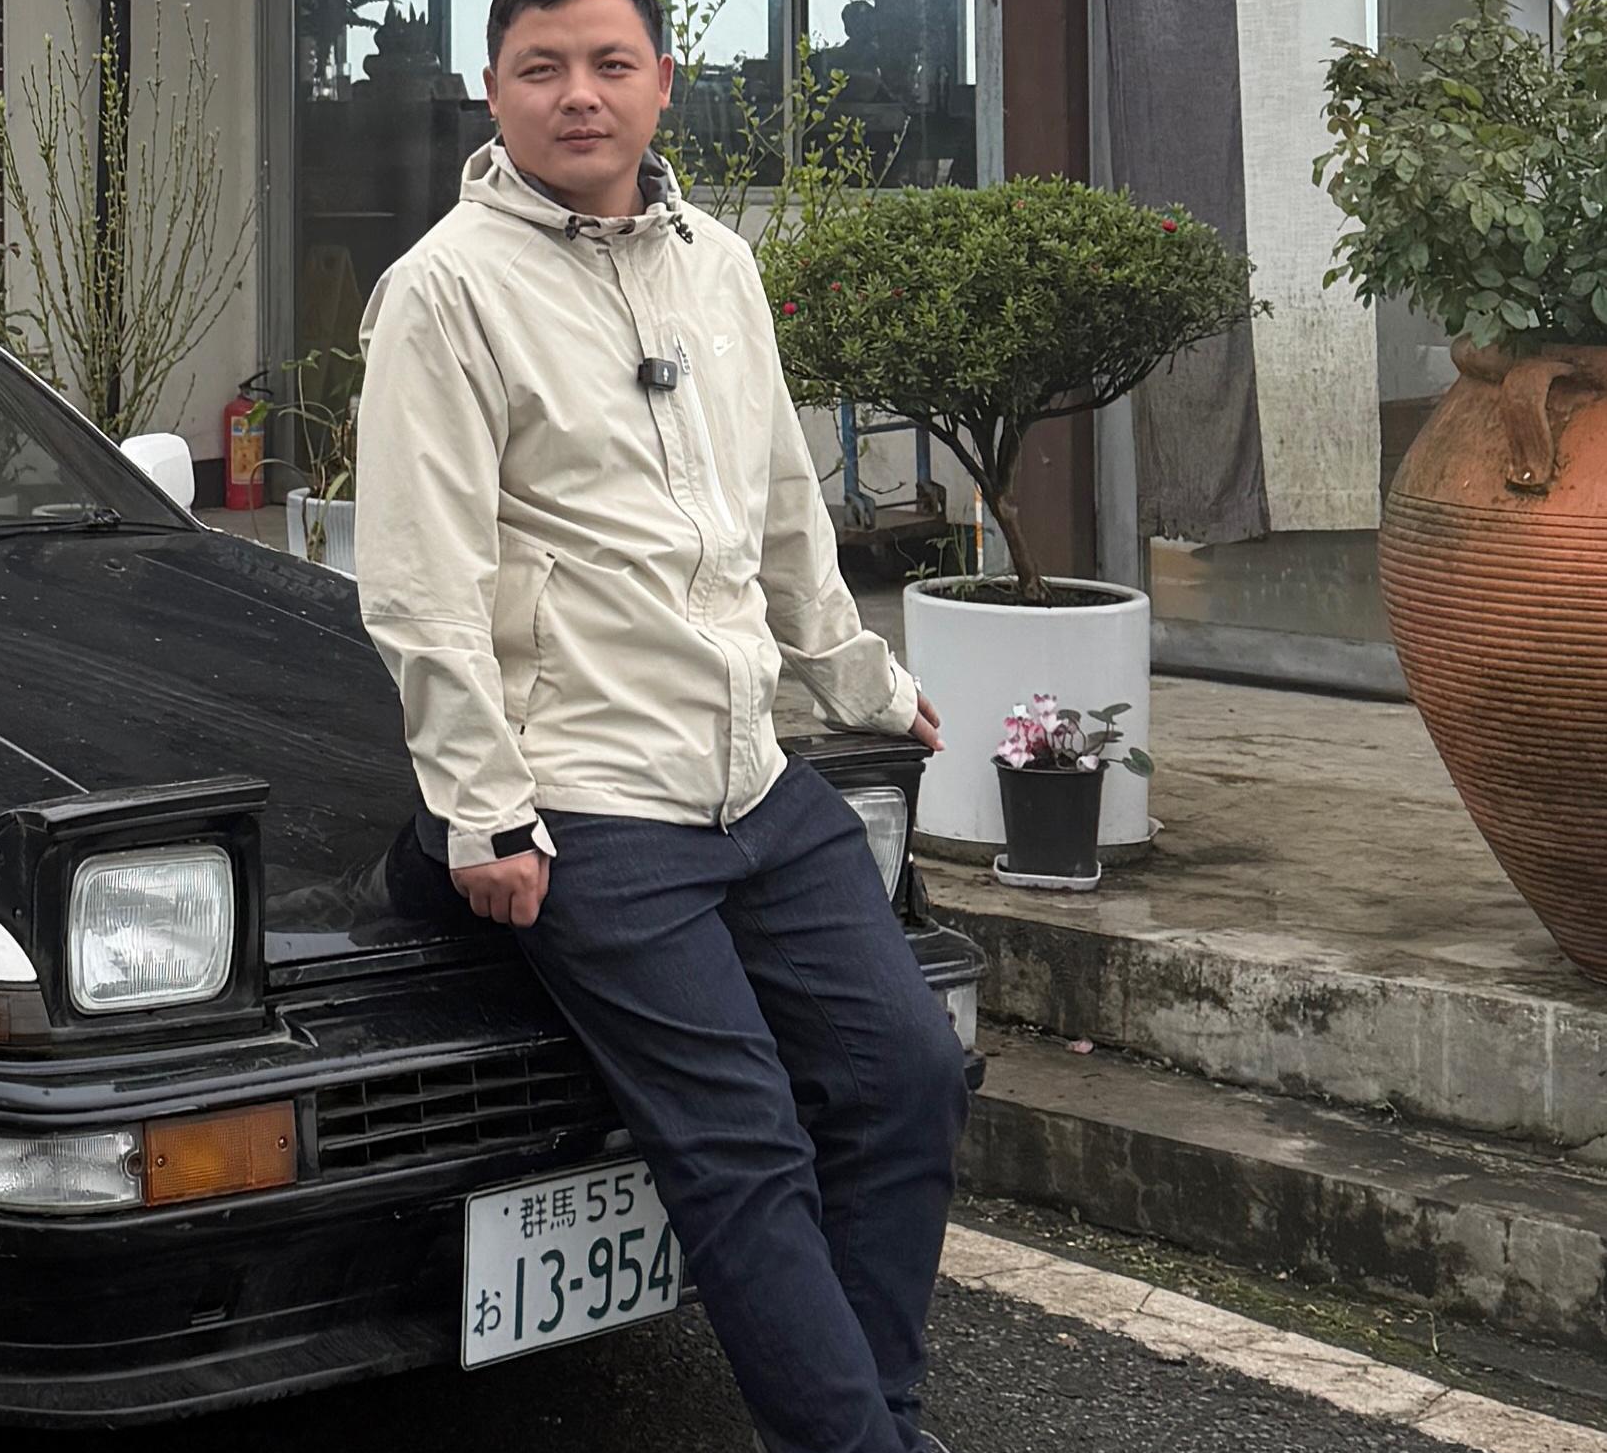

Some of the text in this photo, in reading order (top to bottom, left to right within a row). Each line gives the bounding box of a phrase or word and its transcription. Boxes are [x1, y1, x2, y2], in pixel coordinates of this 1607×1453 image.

[520, 1172, 635, 1240] 群馬 55
[472, 1221, 674, 1341] お 13-954
